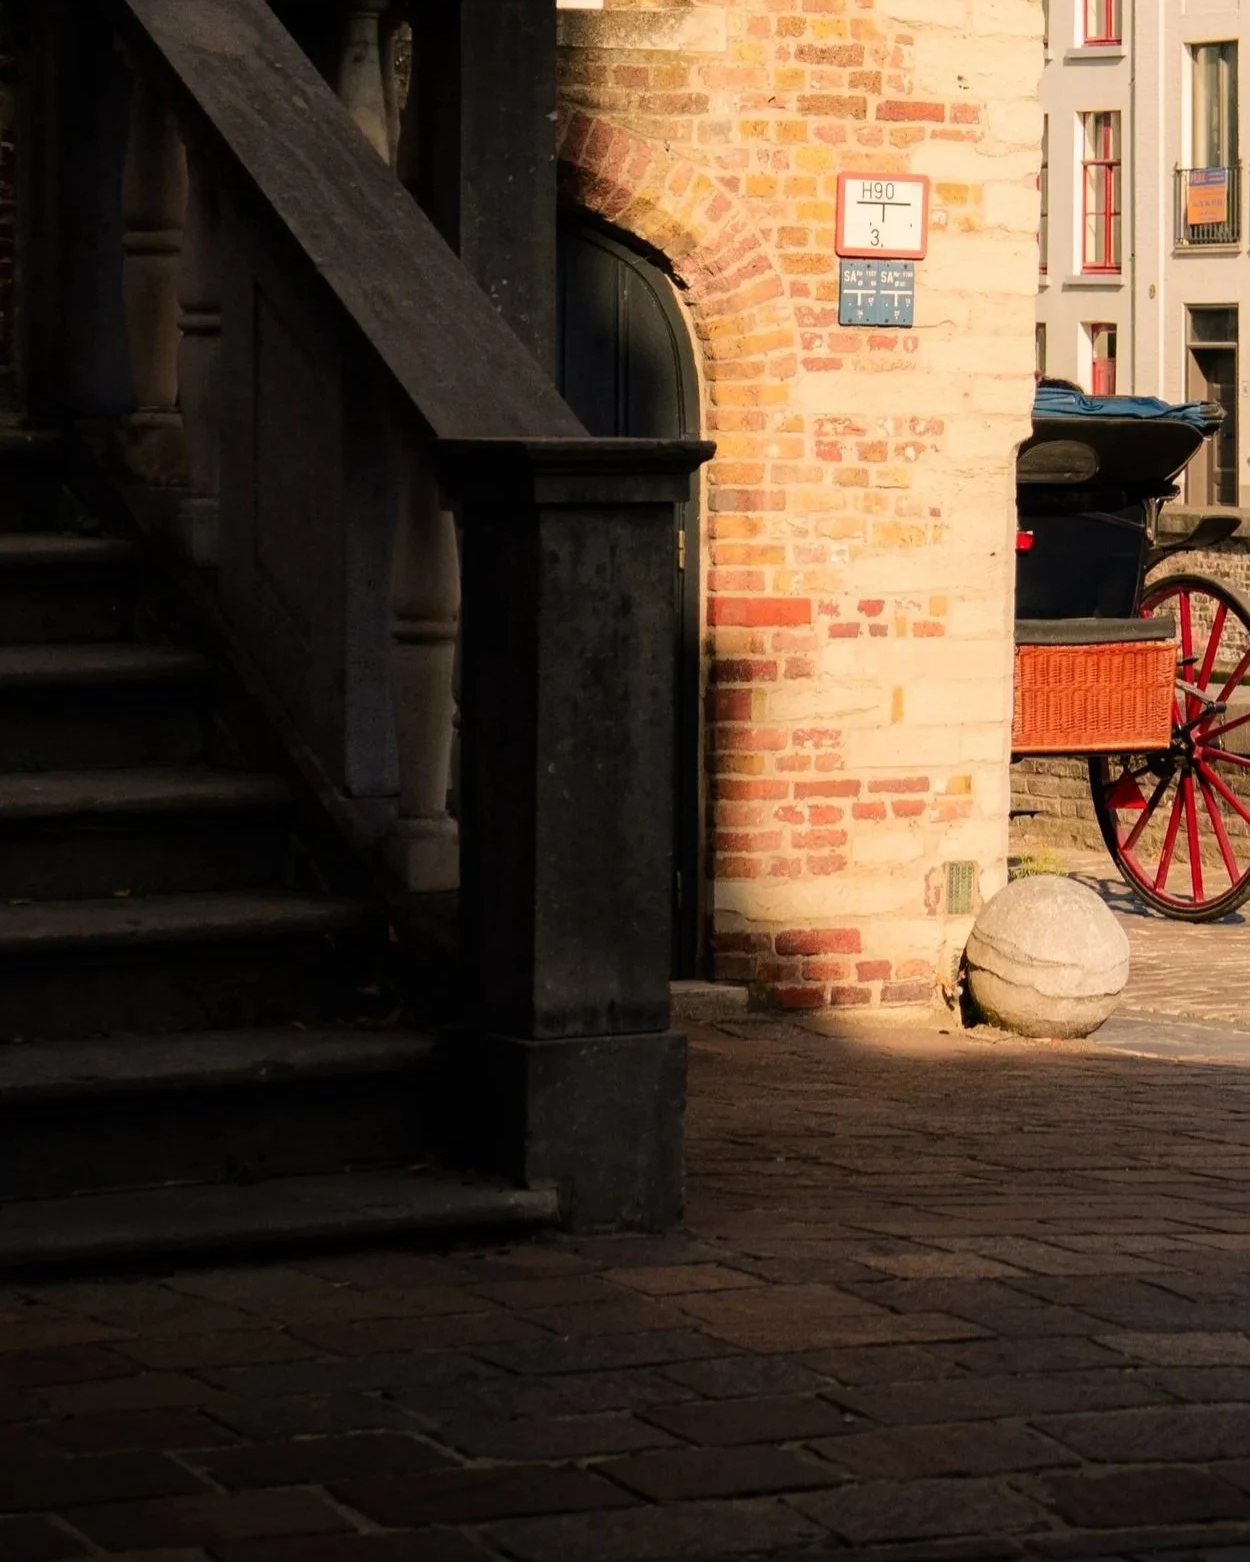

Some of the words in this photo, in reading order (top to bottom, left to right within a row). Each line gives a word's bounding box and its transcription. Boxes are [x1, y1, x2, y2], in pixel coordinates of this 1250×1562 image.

[862, 182, 895, 200] H90
[844, 270, 857, 283] SA
[881, 271, 894, 283] SA
